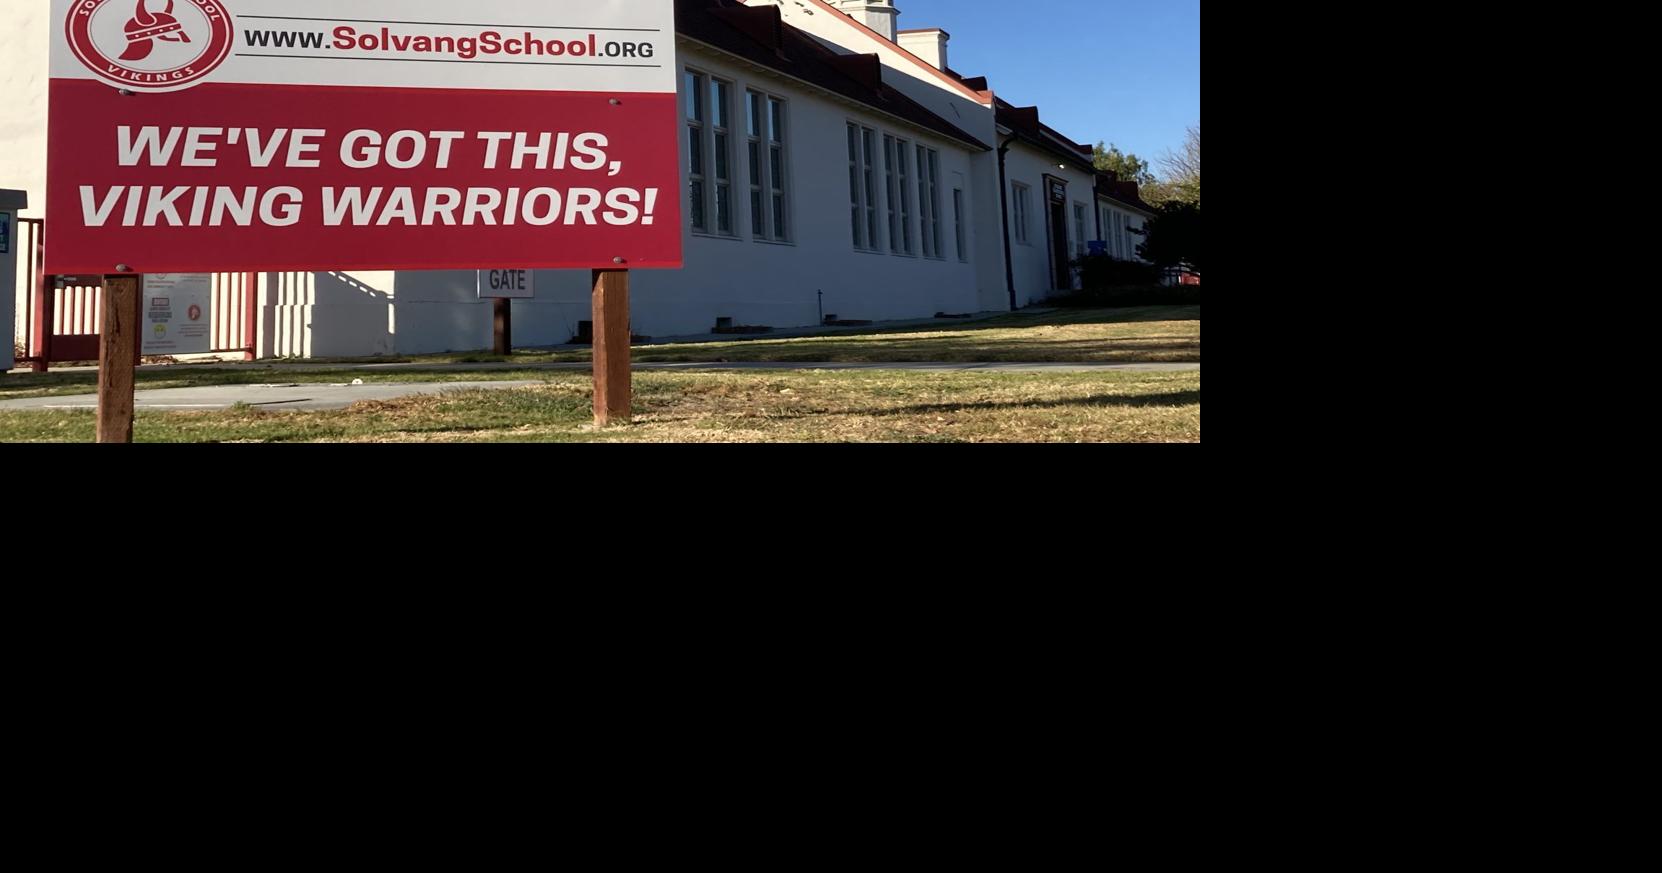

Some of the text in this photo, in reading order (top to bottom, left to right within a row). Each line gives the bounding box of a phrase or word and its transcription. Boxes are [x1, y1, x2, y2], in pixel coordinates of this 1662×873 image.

[107, 64, 194, 82] VIKINGS
[117, 126, 622, 177] WE'VE GOT THIS,
[79, 185, 658, 227] VIKING WARRIORS!
[490, 269, 526, 290] GATE
